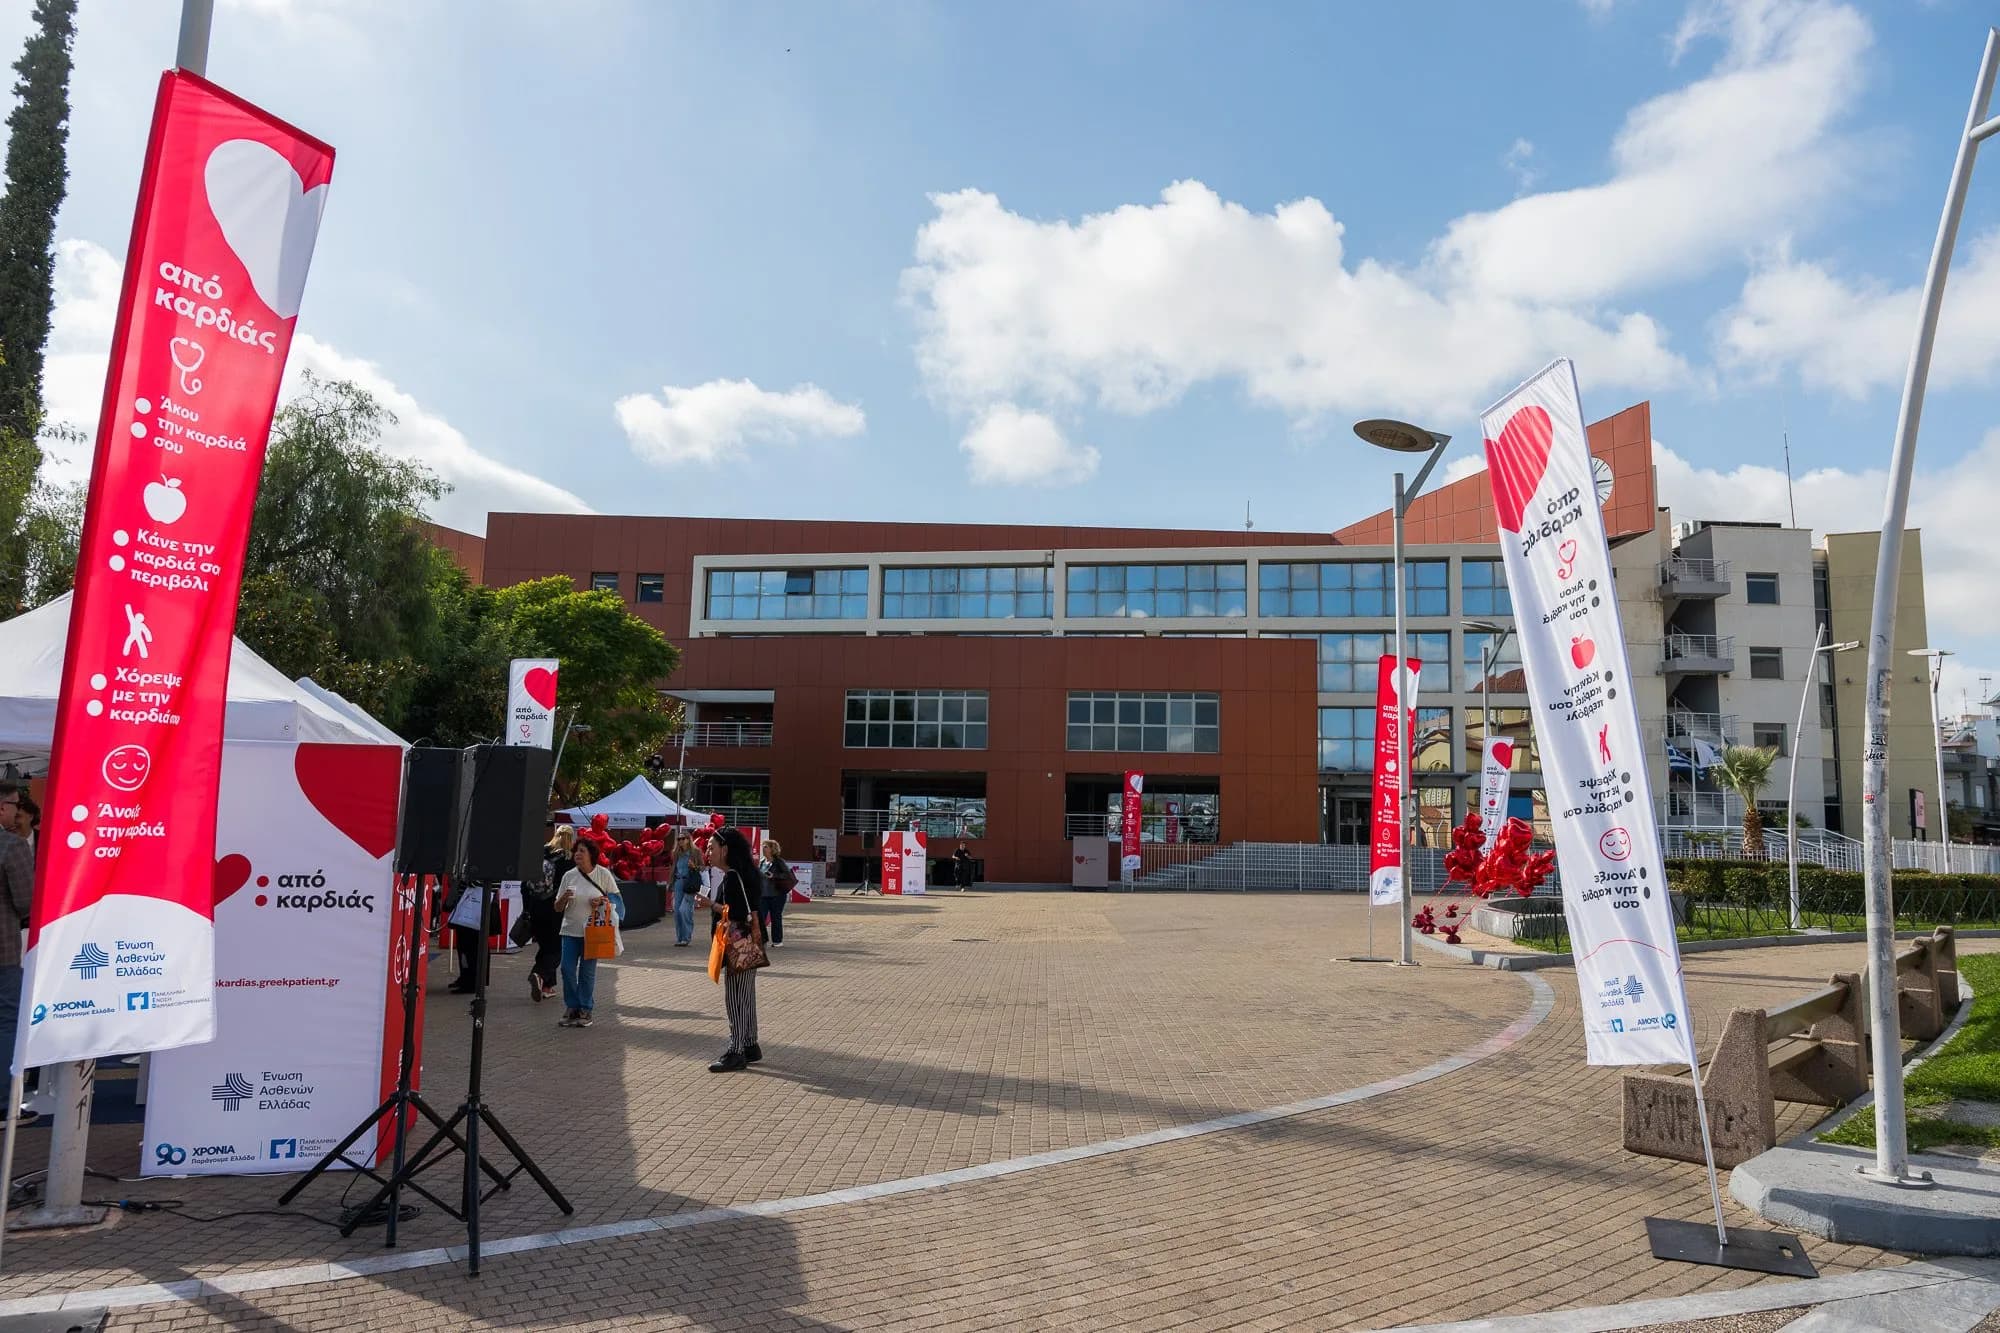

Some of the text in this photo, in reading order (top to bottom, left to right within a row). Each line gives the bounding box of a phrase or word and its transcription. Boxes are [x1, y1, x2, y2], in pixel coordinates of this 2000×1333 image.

[159, 261, 223, 300] από
[154, 286, 277, 354] καρδιάς
[160, 395, 199, 423] Άκου
[157, 416, 247, 451] την καρδιά
[153, 436, 184, 454] σου
[137, 527, 216, 557] Κάνε την
[133, 549, 197, 570] καρδιά
[130, 568, 209, 592] περιβόλι
[114, 666, 182, 689] Χόρεψε
[111, 689, 171, 707] με την
[109, 707, 170, 725] καρδιά
[515, 713, 548, 721] καρδιάς
[96, 825, 126, 842] την
[94, 846, 121, 858] σου
[277, 869, 326, 888] από
[276, 890, 374, 912] καρδιάς
[115, 940, 154, 951] Ένωση
[115, 952, 166, 964] Ασθενών
[115, 966, 163, 977] Ελλάδας
[52, 999, 95, 1012] ΧΡΟΝΙΑ
[262, 1072, 303, 1083] Ένωση
[259, 1085, 314, 1096] Ασθενών
[259, 1100, 311, 1110] Ελλάδας
[155, 1142, 187, 1166] 90
[192, 1144, 236, 1157] ΧΡΟΝΙΑ
[230, 1154, 256, 1162] Ελλάδα
